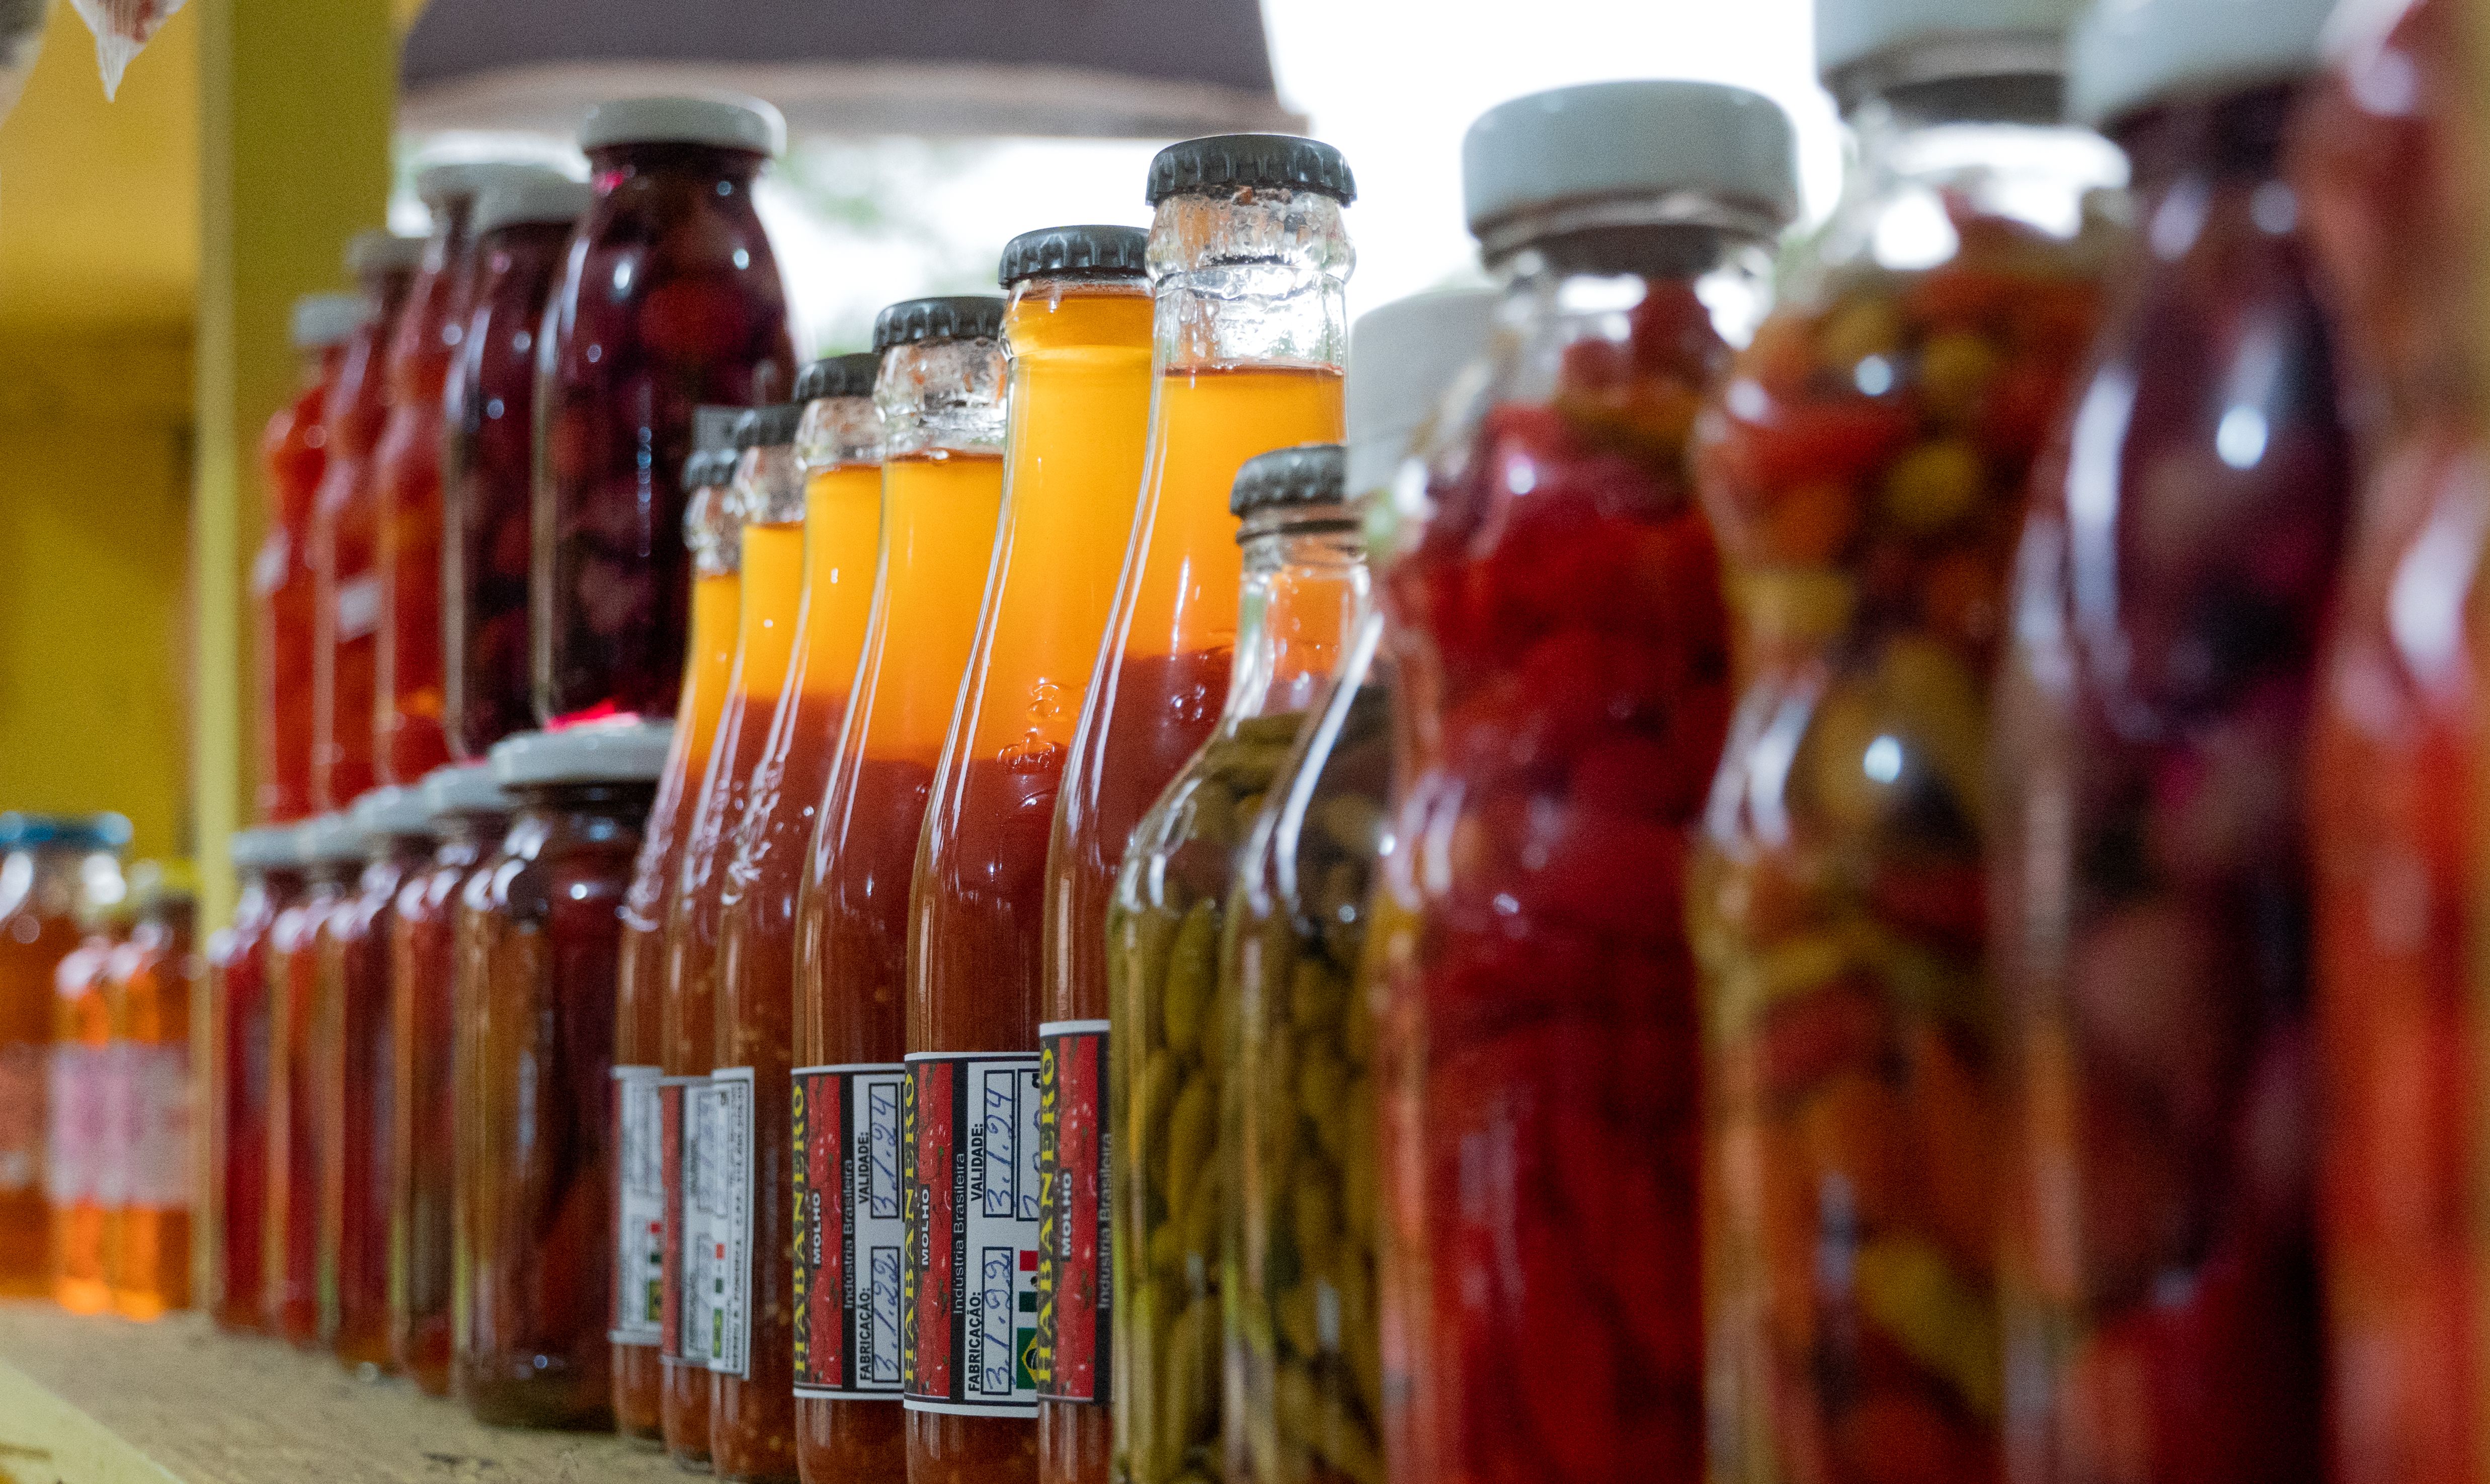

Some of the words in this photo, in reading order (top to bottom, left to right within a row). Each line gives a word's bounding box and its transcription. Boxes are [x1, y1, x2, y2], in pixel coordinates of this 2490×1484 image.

[843, 1159, 854, 1234] Brasileira
[858, 1131, 870, 1204] VALIDADE:
[953, 1153, 965, 1233] Brasileira
[971, 1123, 983, 1202] VALIDADE:
[813, 1192, 821, 1265] MOLHO
[906, 1073, 914, 1383] HABANERO
[1038, 1048, 1055, 1382] HABANERO
[1062, 1173, 1072, 1256] MOLHO
[953, 1240, 964, 1314] Indústria
[857, 1287, 871, 1381] FABRICAÇÃO:
[967, 1291, 982, 1392] FABRICAÇÃO:
